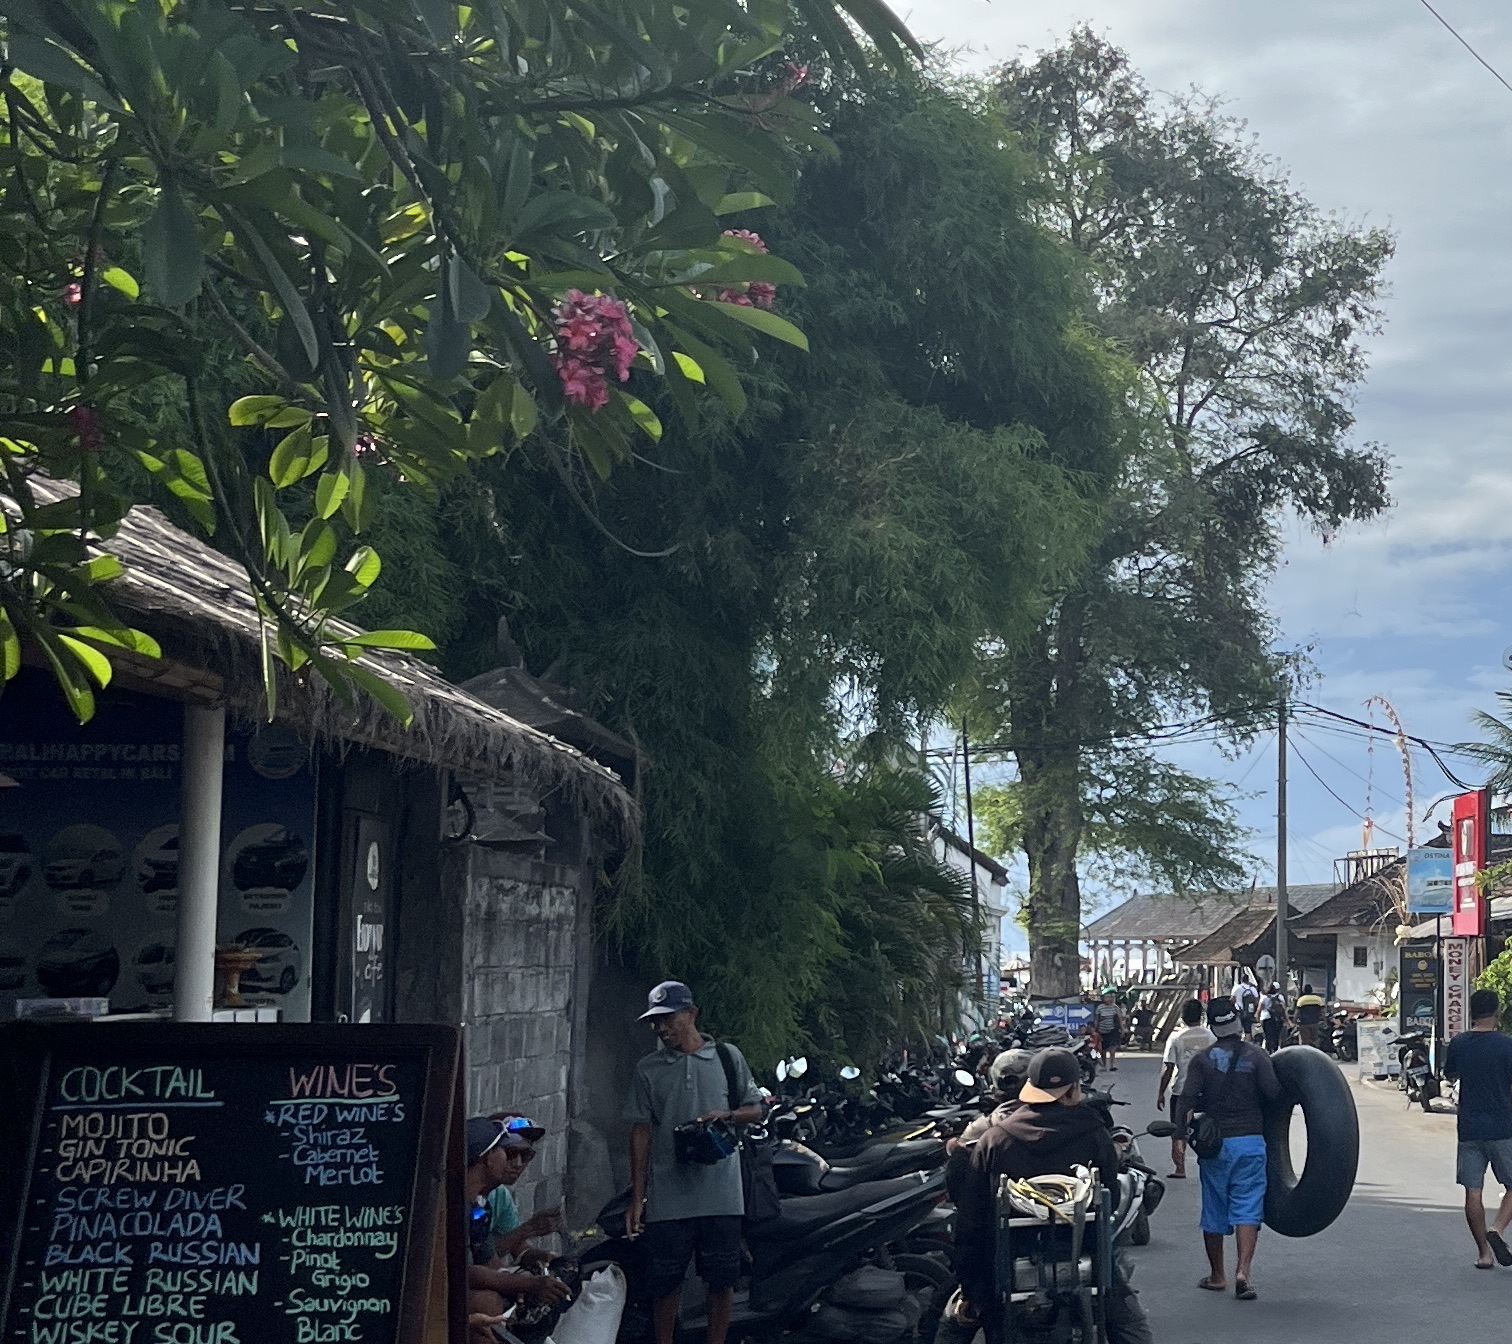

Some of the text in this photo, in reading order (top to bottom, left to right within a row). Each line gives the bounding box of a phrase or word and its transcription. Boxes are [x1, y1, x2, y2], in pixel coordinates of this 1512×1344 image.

[1448, 943, 1463, 981] MONEY
[61, 1066, 215, 1102] COCKTAIL
[289, 1064, 397, 1098] WINE'S
[61, 1112, 170, 1140] MOJITO
[277, 1104, 405, 1127] RED WINE'S
[58, 1136, 196, 1159] GIN TONIC
[292, 1125, 368, 1146] Shiraz
[293, 1144, 380, 1166] Cabernet
[56, 1159, 202, 1185] CAPIRINHA
[54, 1184, 248, 1212] SCREW DIVER
[279, 1205, 405, 1228] WHITE WINE'S
[45, 1241, 261, 1266] BLACK RUSSIAN
[292, 1227, 399, 1259] Chardonnay
[291, 1249, 341, 1274] Pinot
[41, 1267, 260, 1296] WHITE RUSSIAN
[312, 1269, 370, 1295] Grigio
[34, 1294, 207, 1319] CUBE LIBRE
[285, 1288, 392, 1324] Sauvignon
